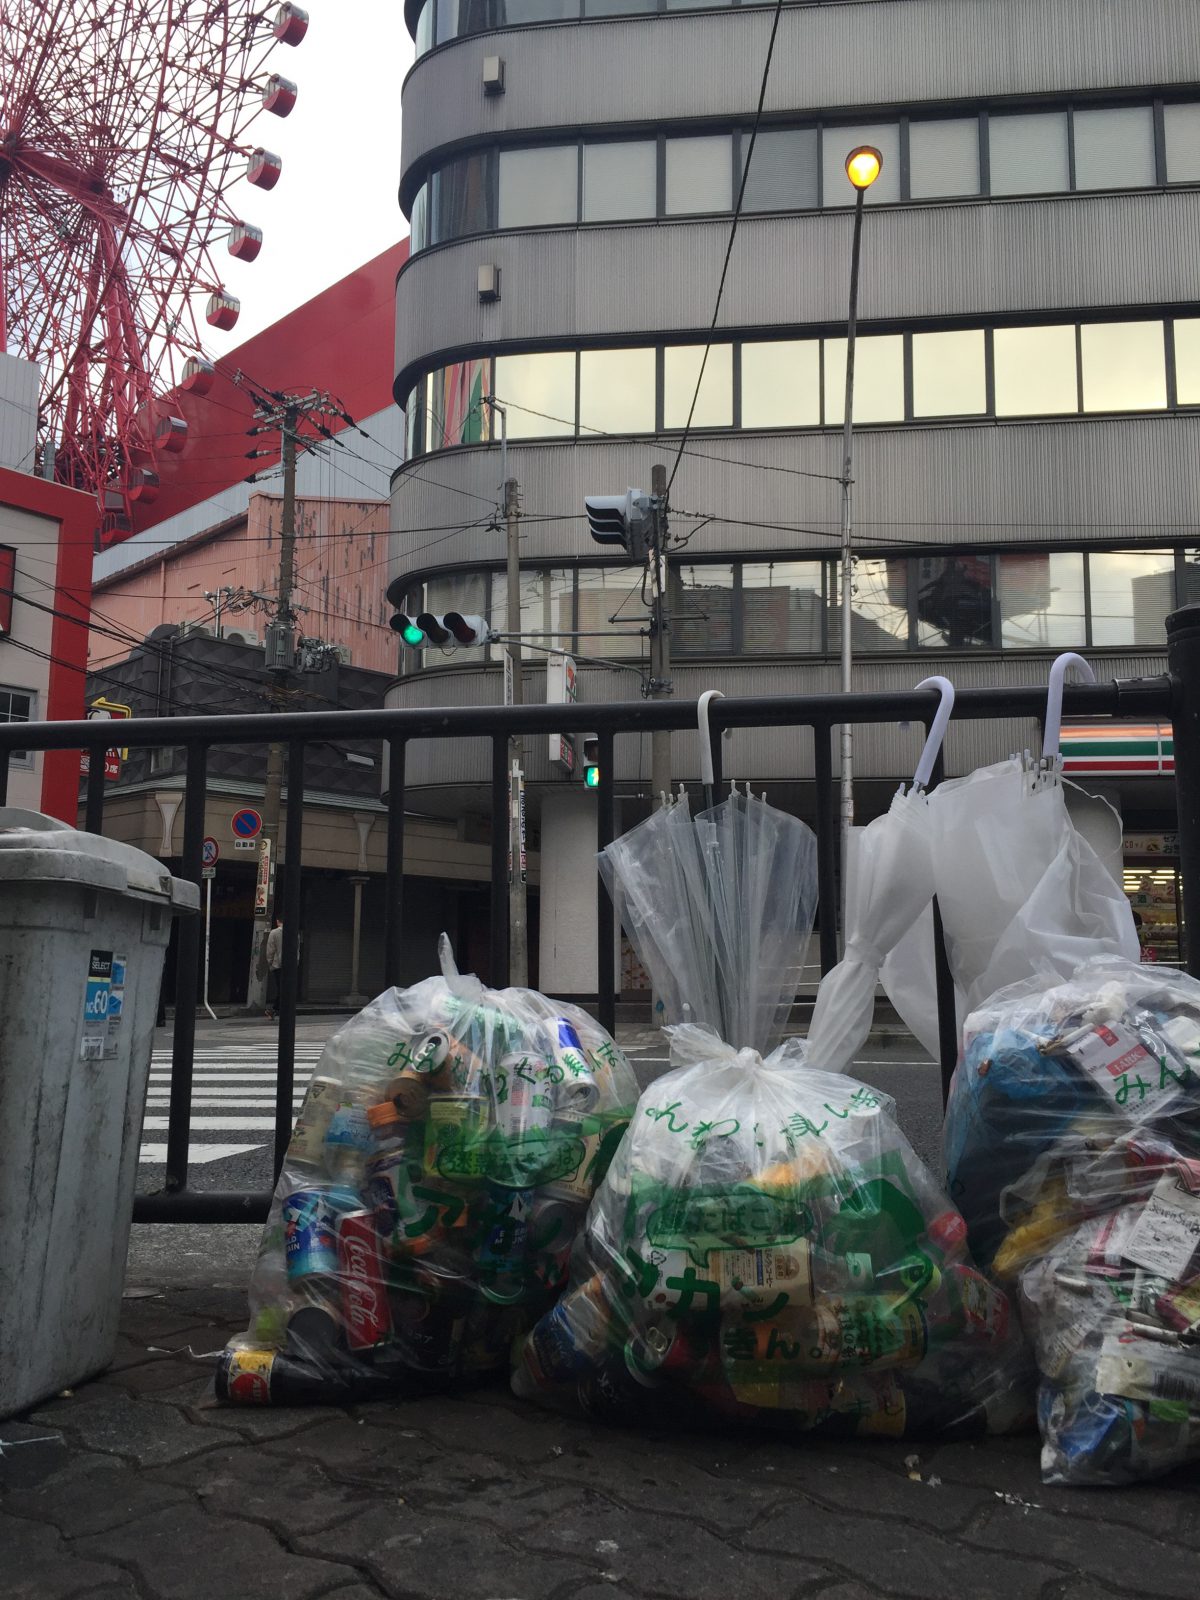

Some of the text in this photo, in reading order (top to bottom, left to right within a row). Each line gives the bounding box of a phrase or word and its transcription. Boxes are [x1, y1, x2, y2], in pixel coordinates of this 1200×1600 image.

[92, 960, 111, 970] SELECT
[1113, 1050, 1142, 1073] LARK
[1113, 1044, 1200, 1105] みん
